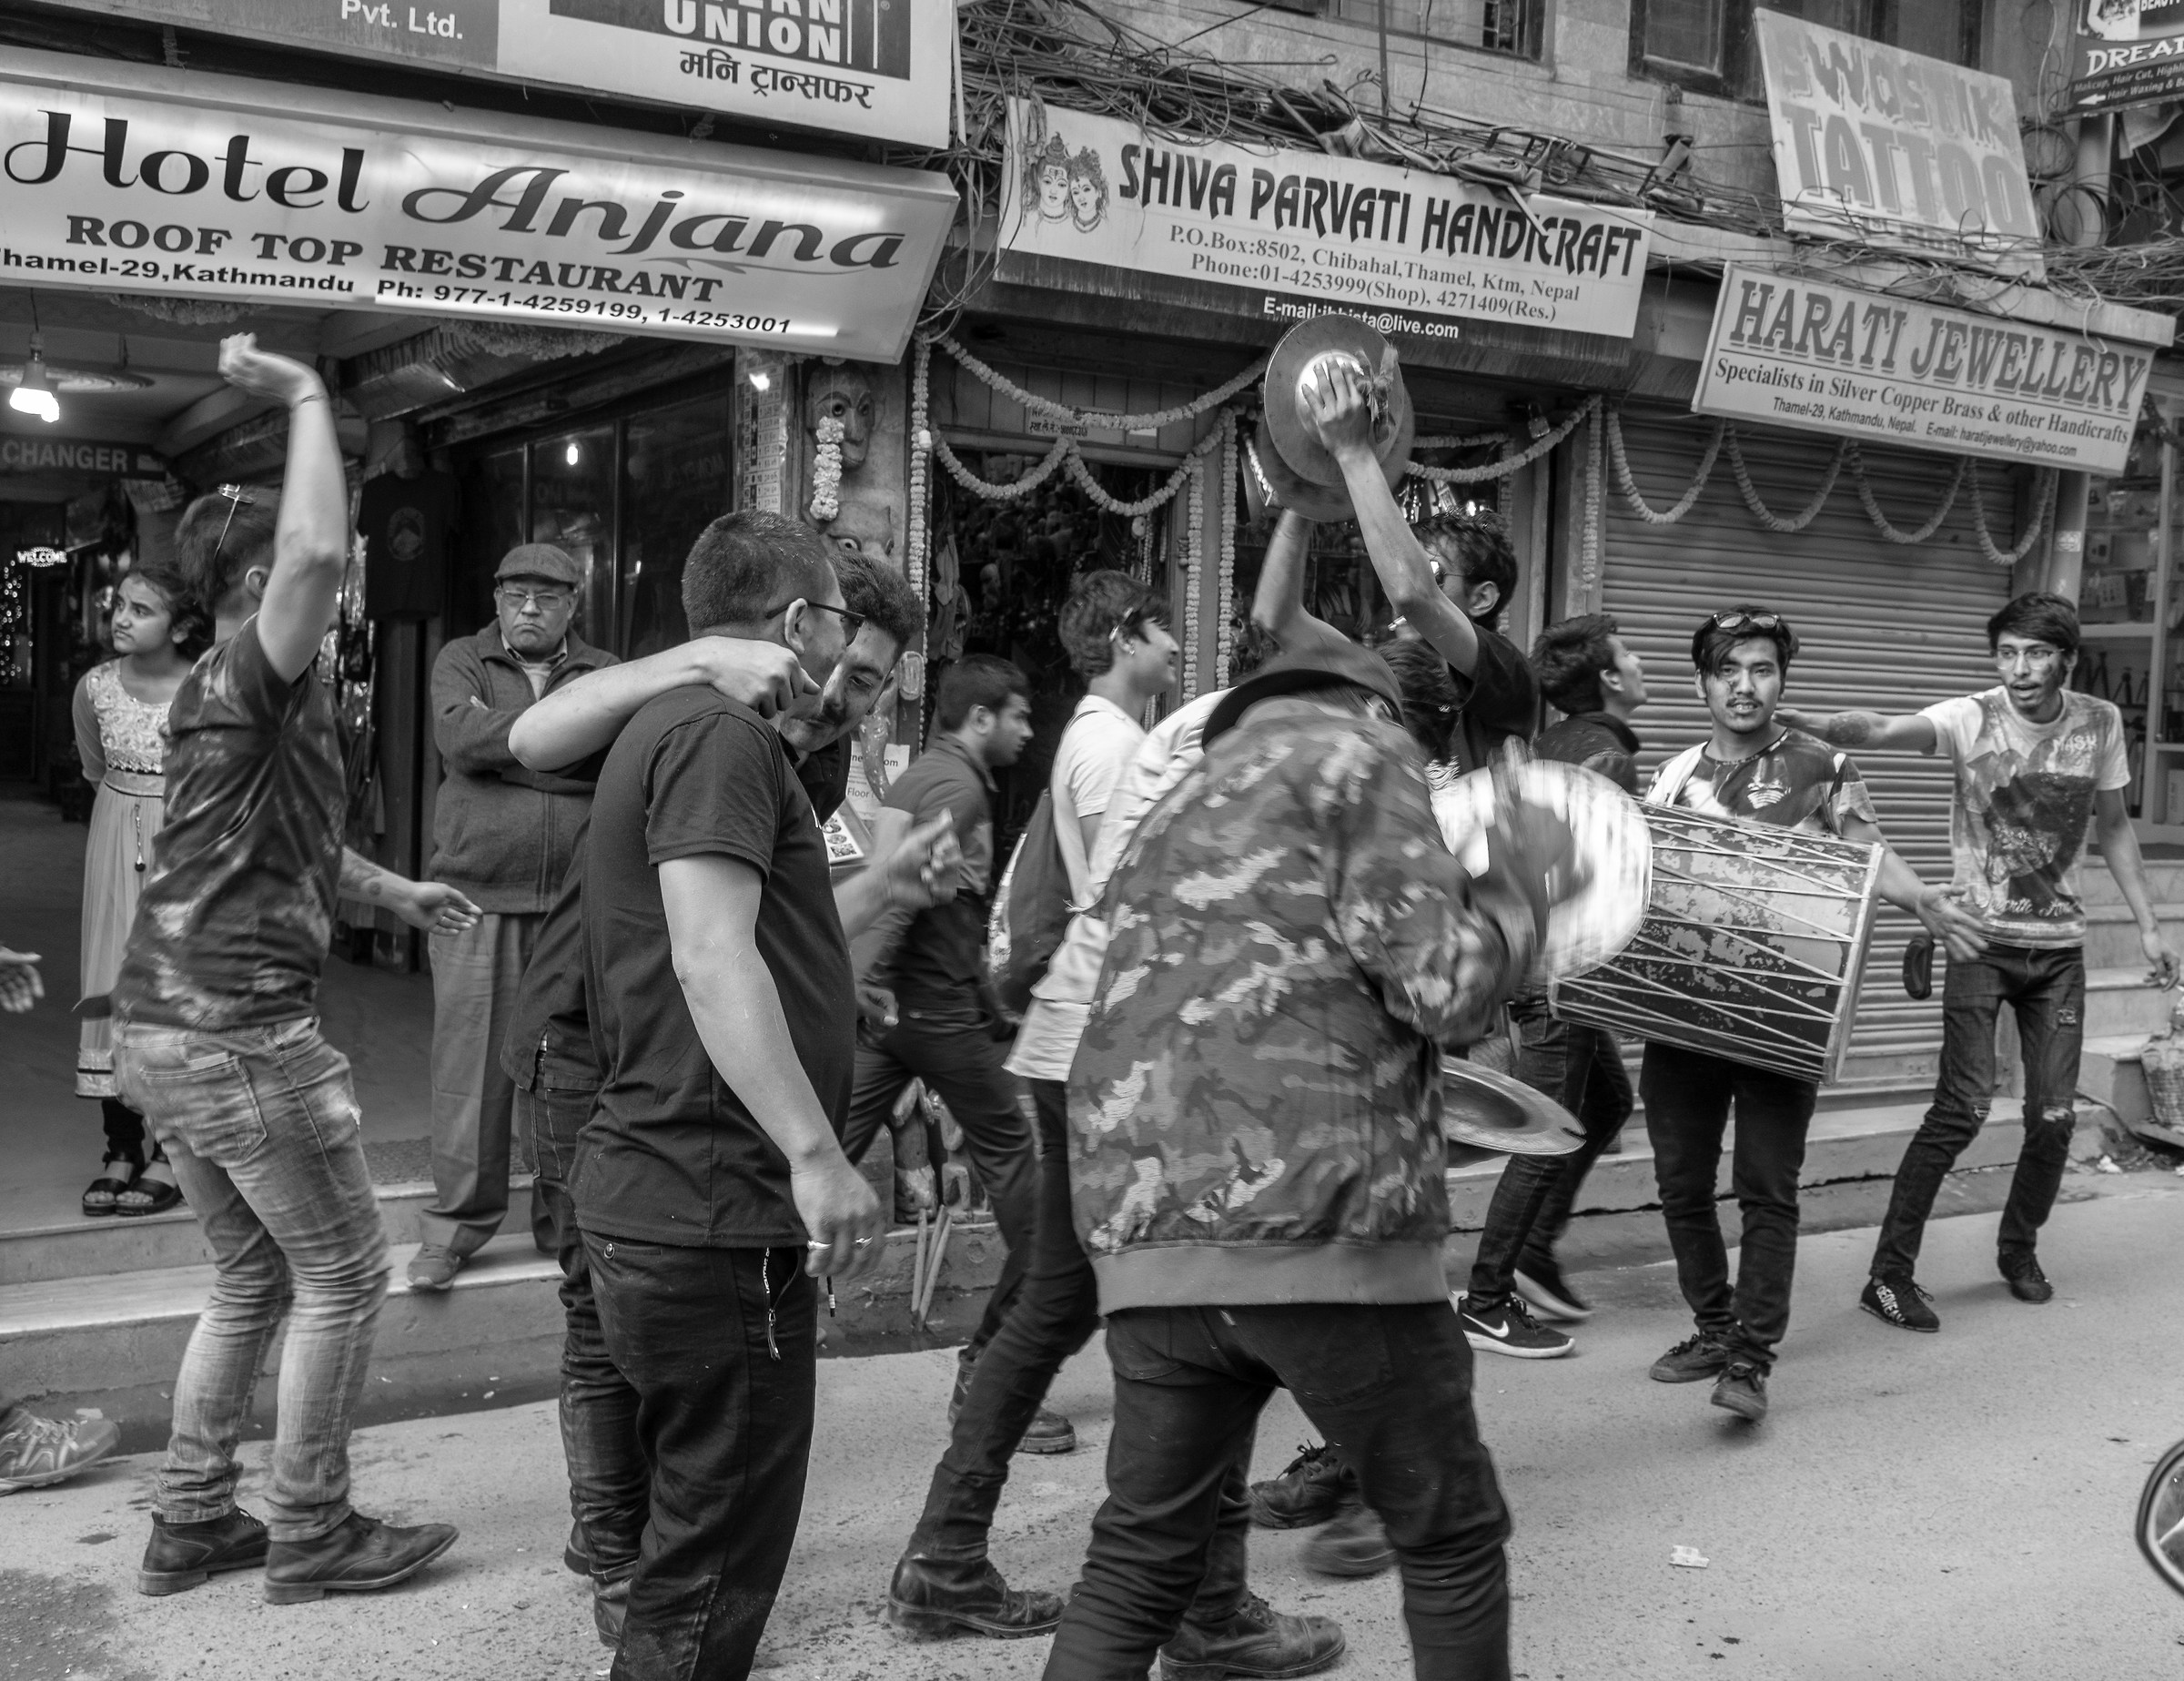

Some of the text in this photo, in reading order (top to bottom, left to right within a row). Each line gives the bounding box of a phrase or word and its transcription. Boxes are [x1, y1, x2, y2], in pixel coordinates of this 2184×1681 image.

[341, 0, 463, 39] Pvt. Ltd.
[663, 0, 841, 63] UNION
[680, 48, 875, 109] मनि ट्रान्सफर
[4, 109, 905, 268] Hotel Anjana
[1780, 102, 2037, 238] TATTOO
[1119, 144, 1642, 279] SHIVA PARVATI HANDICRAFT
[0, 248, 354, 293] hamel-29,Kathmandu
[66, 215, 723, 303] ROOF TOP RESTAURANT
[1169, 225, 1307, 265] P.O.Box:8502,
[1482, 273, 1525, 296] Ktm,
[1531, 279, 1580, 305] Nepal
[377, 279, 791, 334] Ph: 977-1-4259199, 1-4253001
[1437, 291, 1557, 323] 4271409(Res.)
[1729, 279, 2148, 414] HARATI JEWELLERY
[1715, 358, 2129, 445] Specialists in Silver Copper Brass & other Handicrafts
[1774, 397, 1825, 421] Thamel-29,
[1828, 406, 1886, 430] Kathmandu,
[1887, 416, 1916, 434] Nepal.
[1926, 422, 1958, 440] E-mail:
[2, 440, 128, 472] CHANGER
[16, 549, 67, 565] WELCOME
[847, 787, 869, 798] Floor
